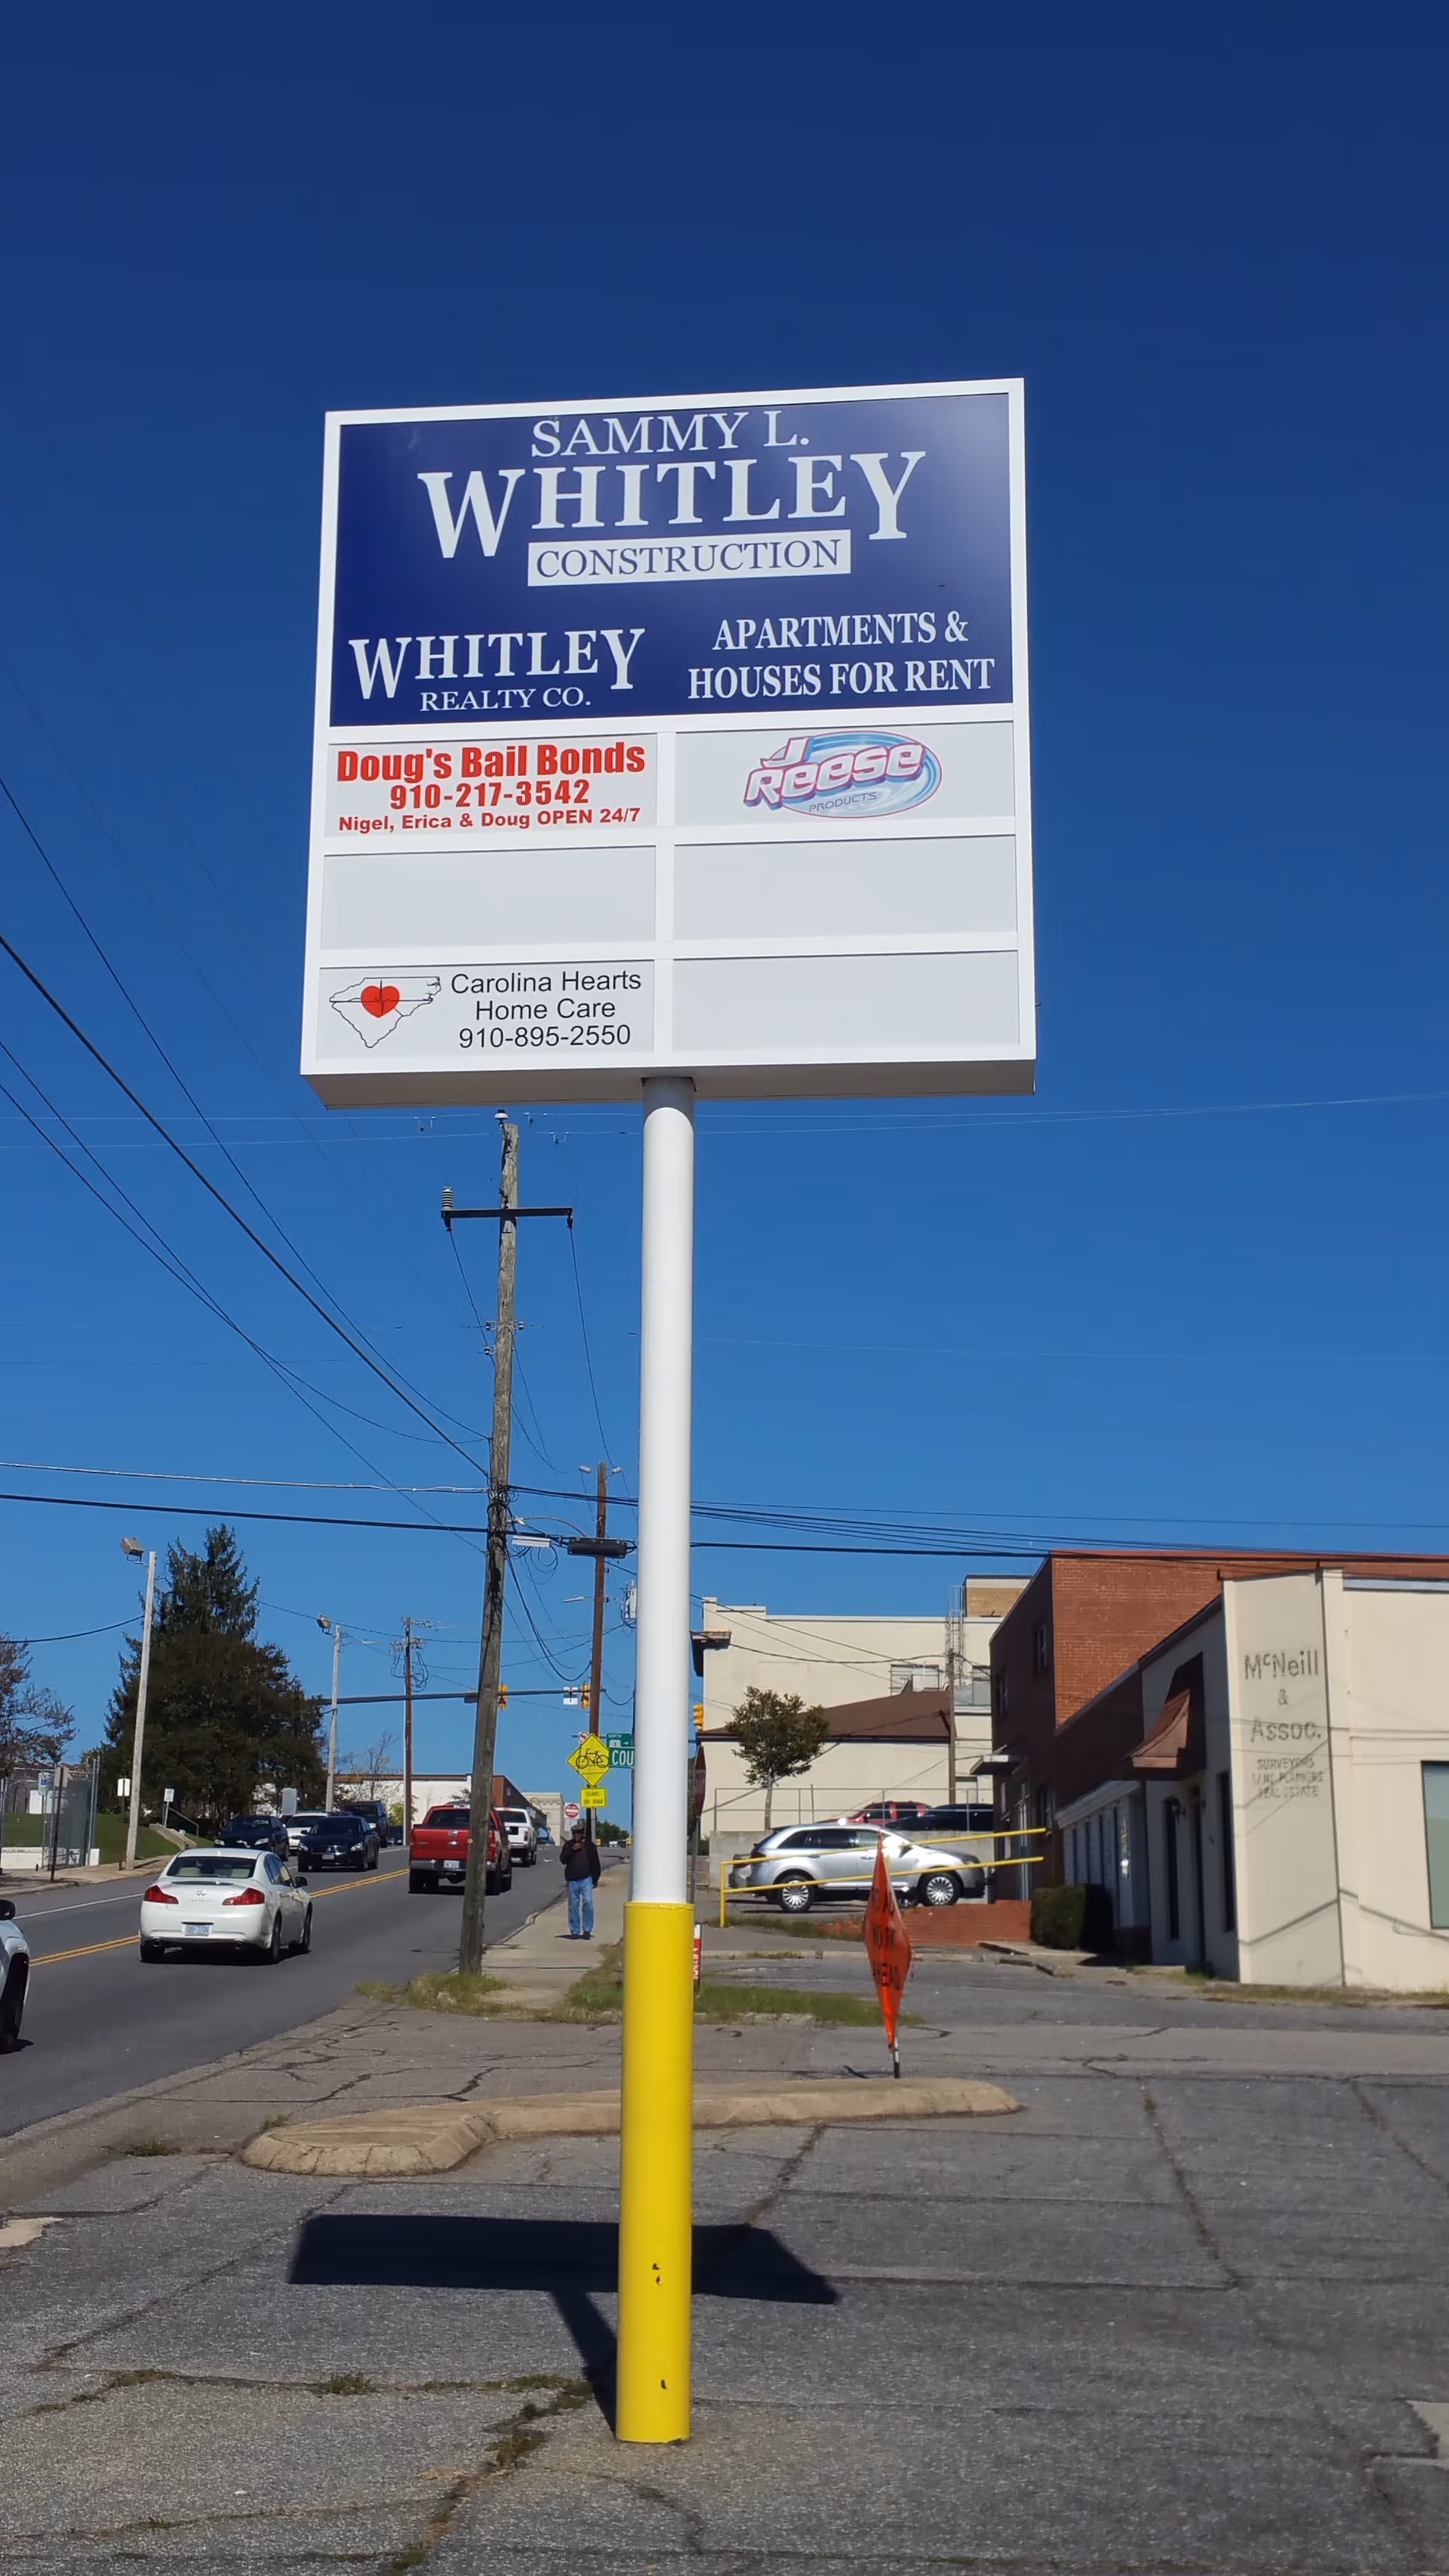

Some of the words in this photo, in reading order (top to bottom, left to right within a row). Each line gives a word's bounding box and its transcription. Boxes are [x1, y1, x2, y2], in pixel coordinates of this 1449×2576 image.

[532, 411, 749, 457] SAMMY
[763, 411, 810, 447] L.
[417, 451, 926, 559] WHITLEY
[537, 539, 841, 577] CONSTRUCTION
[712, 611, 936, 651] APARTMENTS
[945, 611, 968, 642] &
[348, 628, 645, 700] WHITLEY
[688, 664, 820, 699] HOUSES
[830, 660, 898, 694] FOR
[905, 658, 995, 691] RENT
[420, 688, 536, 711] REALTY
[543, 686, 591, 707] CO.
[337, 748, 452, 783] Doug's
[461, 745, 527, 777] Bail
[537, 742, 646, 775] Bonds
[743, 743, 925, 810] Reese
[389, 779, 589, 810] 910-217-3542
[810, 791, 877, 812] PRODUCTS
[339, 815, 394, 834] Nigel,
[401, 814, 452, 829] Erica
[460, 813, 473, 827] &
[481, 811, 530, 829] Doug
[537, 809, 592, 824] OPEN
[600, 807, 641, 823] 24/7
[452, 972, 552, 994] Carolina
[561, 971, 641, 991] Hearts
[476, 1000, 547, 1020] Home
[557, 998, 616, 1018] Care
[459, 1024, 631, 1048] 910-895-2550
[1278, 1688, 1287, 1706] &
